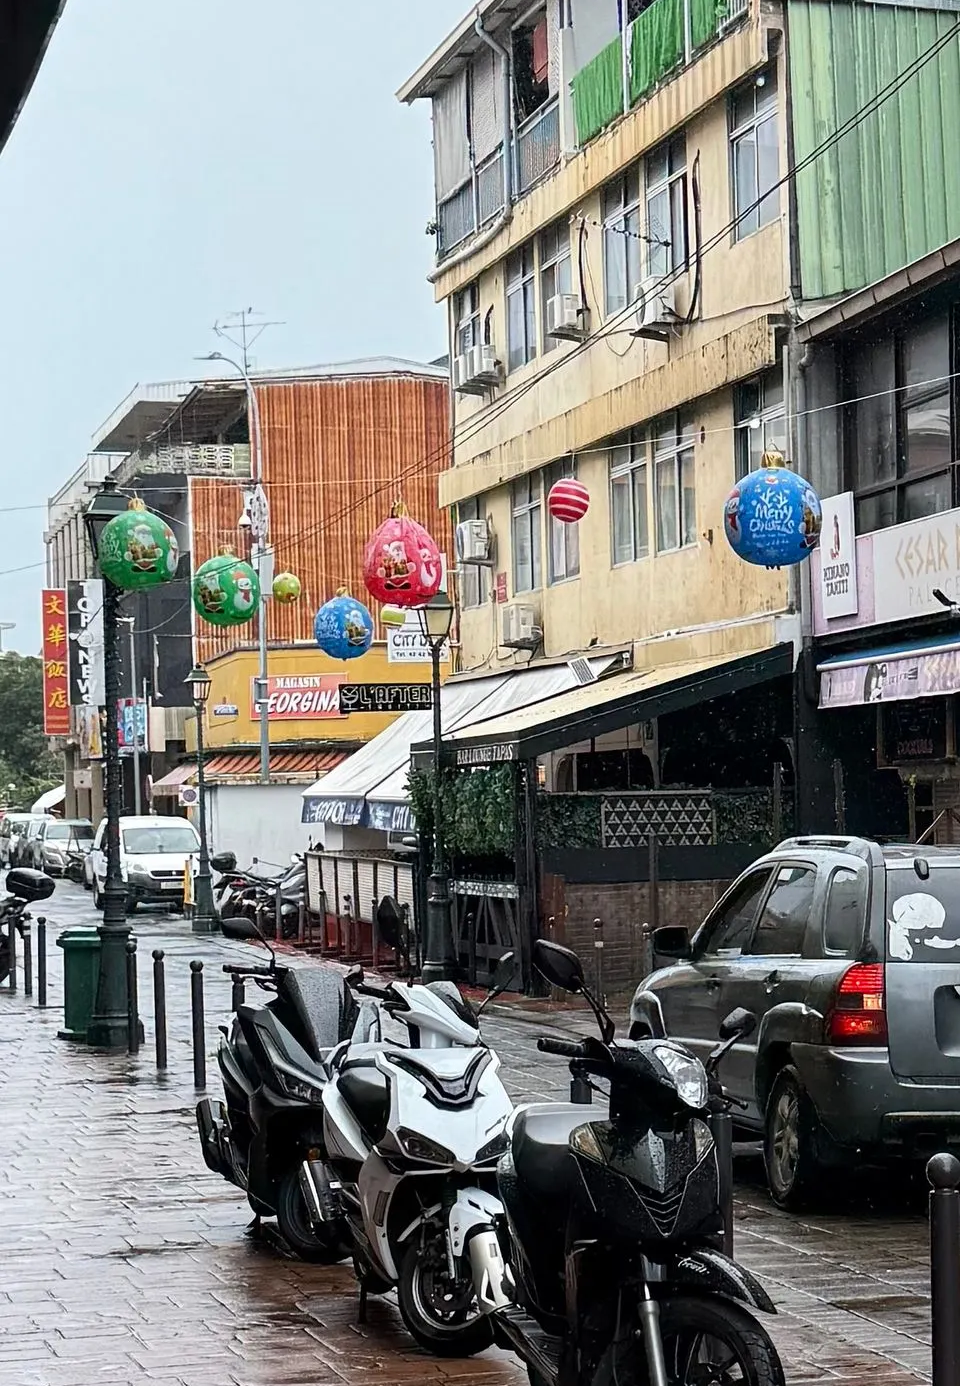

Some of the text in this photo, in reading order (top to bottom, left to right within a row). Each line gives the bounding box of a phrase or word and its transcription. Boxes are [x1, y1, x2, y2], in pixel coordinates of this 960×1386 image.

[755, 503, 793, 523] Merry
[895, 528, 950, 579] CESAR
[826, 580, 849, 597] TAHITI
[909, 575, 960, 606] PALCE
[393, 634, 417, 647] CITY
[45, 595, 67, 709] 文華飯店
[77, 650, 97, 705] NEWS
[276, 677, 321, 689] MAGASIN
[359, 685, 431, 704] L'AFTER
[493, 744, 514, 762] TAPAS
